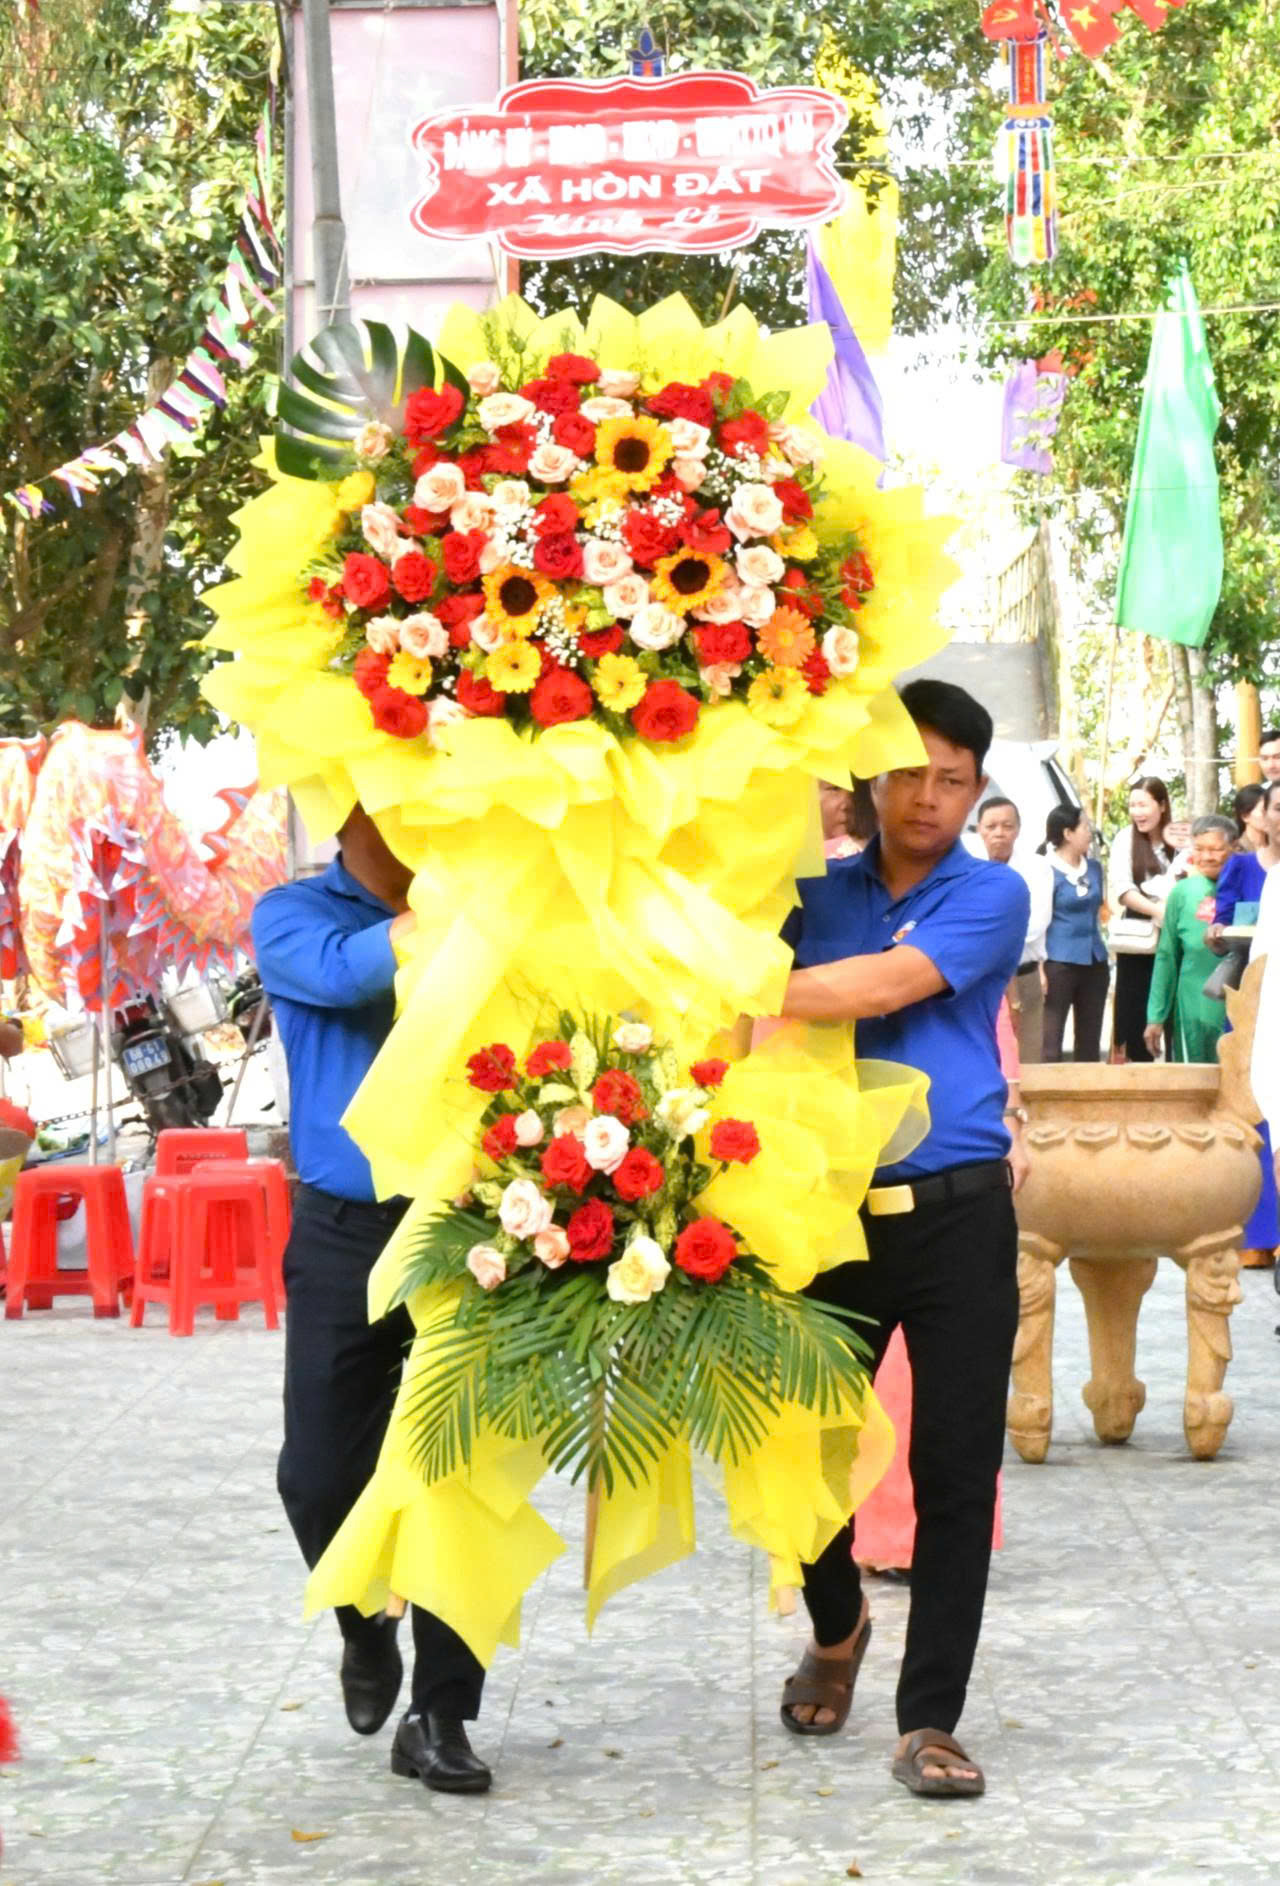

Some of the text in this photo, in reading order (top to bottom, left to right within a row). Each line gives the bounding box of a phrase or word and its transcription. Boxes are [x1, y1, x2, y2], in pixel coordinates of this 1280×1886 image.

[487, 163, 771, 205] XÃ HÒN ĐẤT
